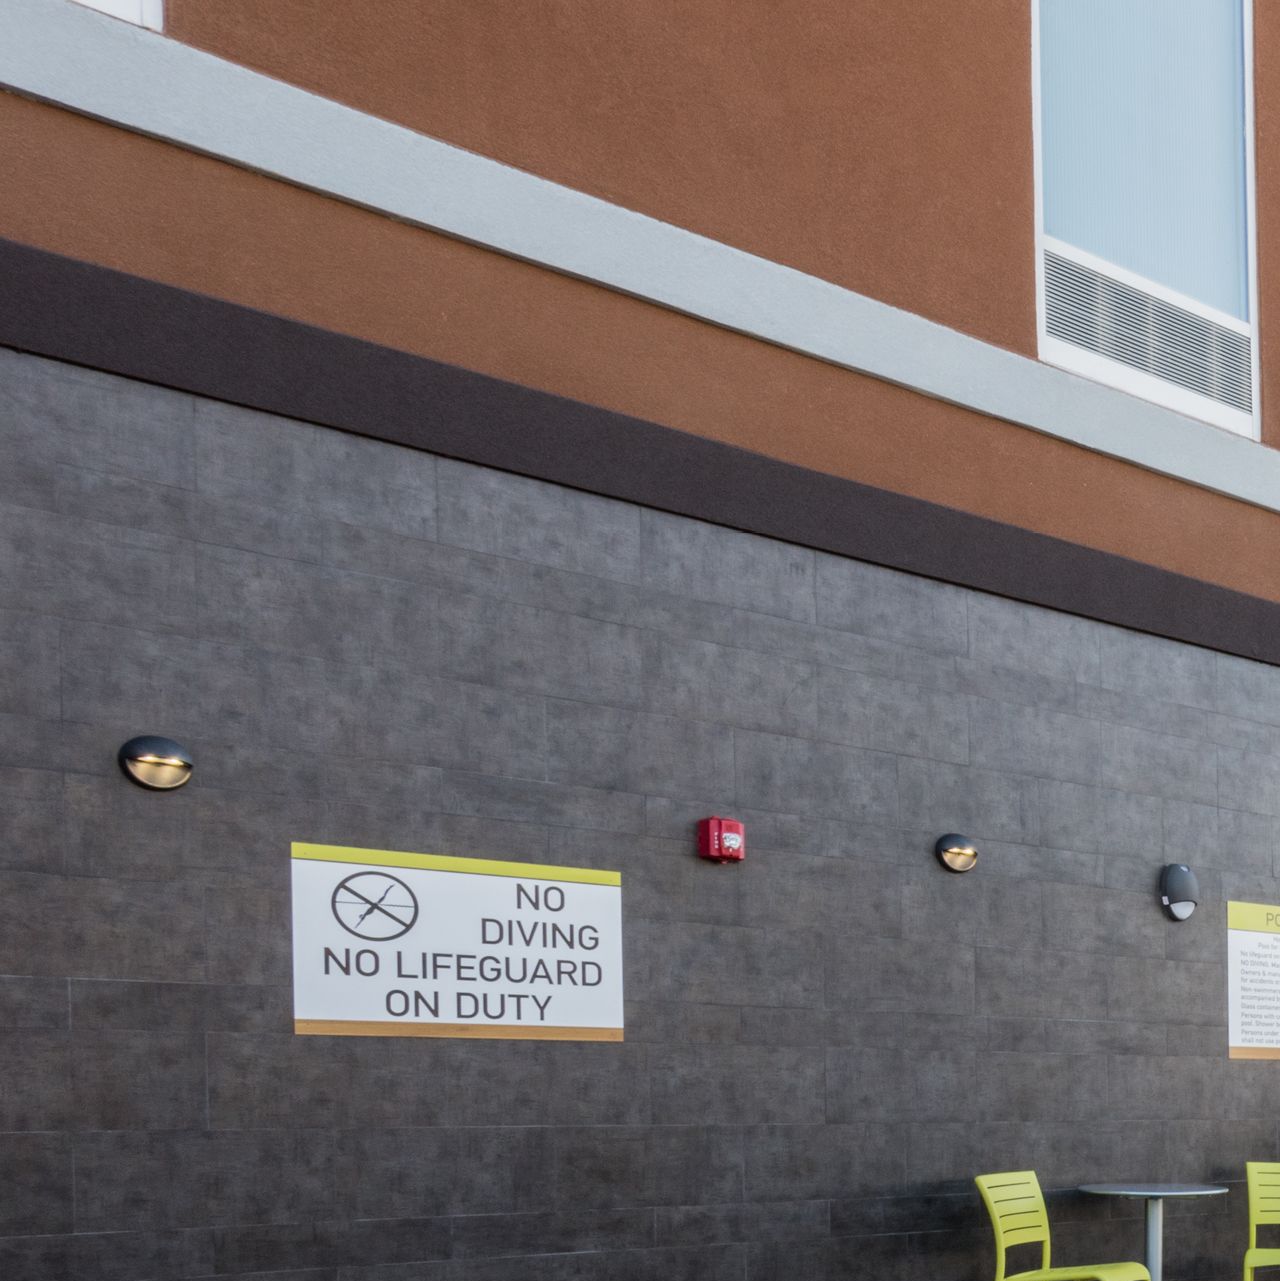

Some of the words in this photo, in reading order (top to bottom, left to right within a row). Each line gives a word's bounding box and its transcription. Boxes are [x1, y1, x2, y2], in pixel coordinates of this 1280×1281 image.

[515, 882, 566, 912] NO
[480, 917, 601, 951] DIVING
[322, 945, 381, 977] NO
[396, 949, 603, 987] LIFEGUARD
[385, 988, 441, 1019] ON
[455, 990, 553, 1022] DUTY
